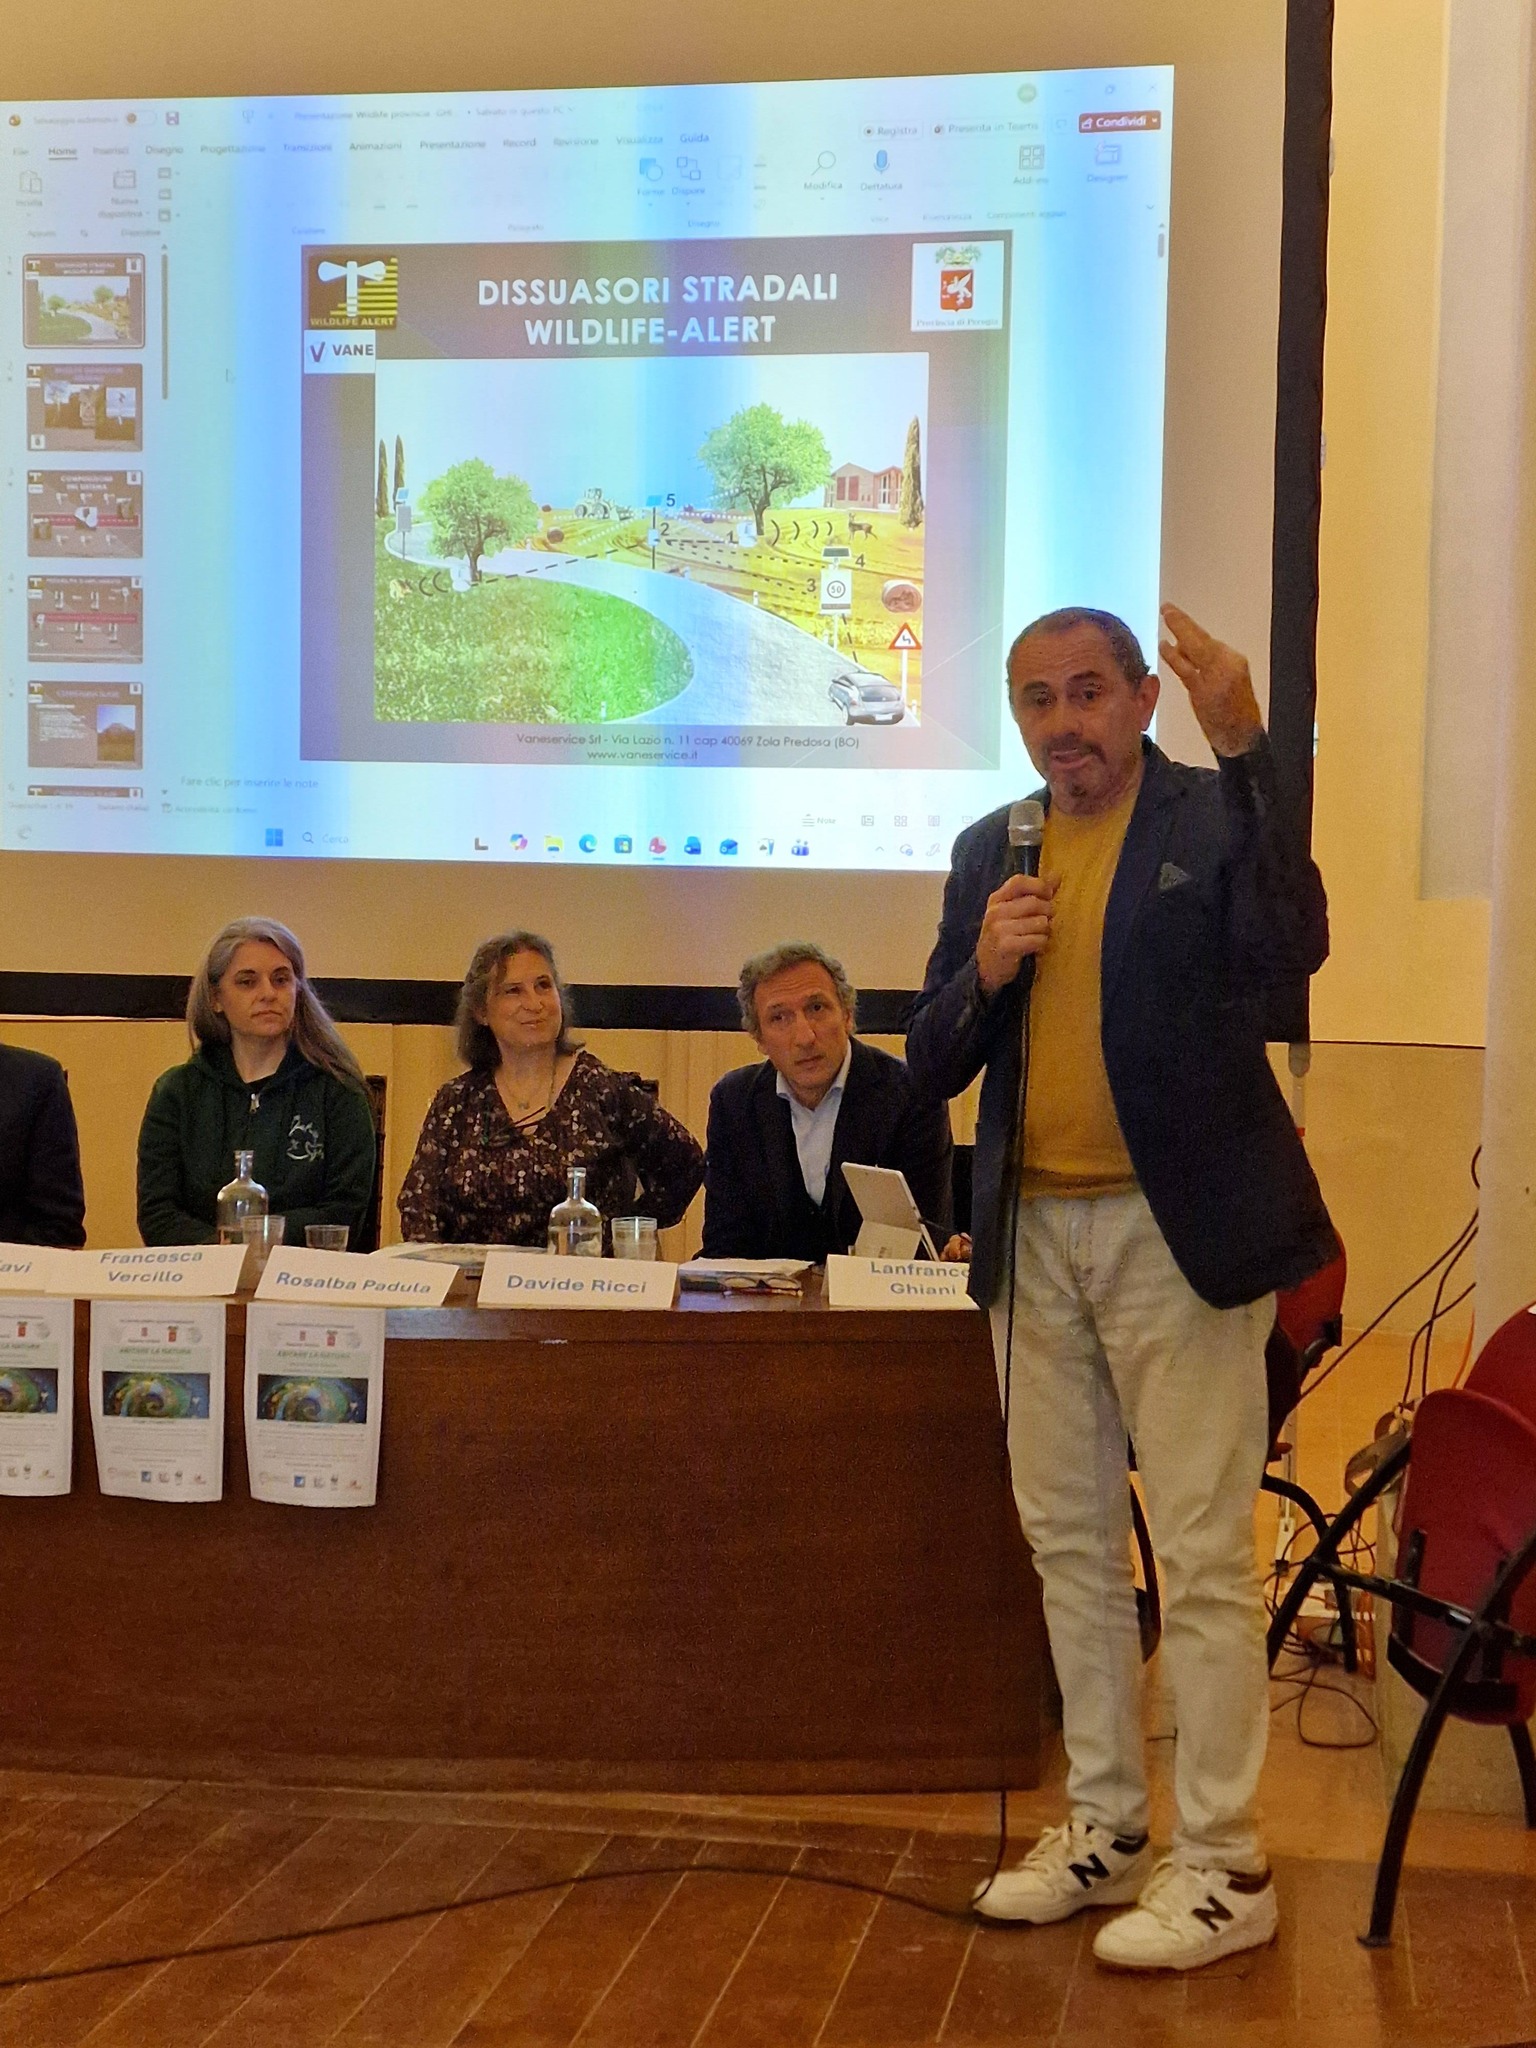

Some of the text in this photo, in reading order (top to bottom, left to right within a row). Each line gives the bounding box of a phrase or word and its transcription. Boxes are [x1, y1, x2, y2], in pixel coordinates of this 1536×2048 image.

[948, 122, 992, 134] Presenta
[1096, 116, 1147, 127] Condividi
[420, 139, 486, 150] Presentazione
[503, 137, 536, 147] Record
[616, 135, 664, 145] Visualizza
[680, 132, 710, 144] Guida
[48, 146, 77, 156] Home
[145, 145, 184, 157] Disegno
[349, 141, 402, 151] Animazioni
[803, 180, 843, 190] Modifica
[860, 181, 903, 191] Dettatura
[478, 273, 838, 307] DISSUASORI STRADALI
[310, 317, 395, 327] WILDLIFE ALERT
[524, 315, 777, 346] WILDLIFE-ALERT
[331, 344, 375, 357] VANE
[666, 493, 676, 508] 5
[660, 522, 671, 537] 2
[855, 553, 866, 567] 4
[806, 578, 817, 593] 3
[831, 585, 842, 594] 50
[516, 733, 586, 745] Vaneservice
[588, 733, 602, 745] Srl
[611, 734, 630, 745] Via
[633, 735, 661, 746] Lazio
[664, 737, 674, 746] n.
[678, 735, 690, 746] 11
[694, 737, 717, 748] cap
[721, 735, 753, 747] 40069
[756, 736, 780, 747] Zola
[784, 736, 832, 748] Predosa
[834, 736, 860, 750] (BO)
[587, 750, 698, 761] www.vaneservice.it
[294, 778, 319, 789] note
[99, 1251, 203, 1265] Francesca
[0, 1260, 33, 1274] avi
[107, 1270, 184, 1284] Vercillo
[275, 1271, 432, 1294] Rosalba Padula
[507, 1274, 647, 1294] Davide Ricci
[889, 1282, 956, 1296] Ghiani
[1067, 1852, 1111, 1890] N
[1191, 1895, 1235, 1933] N
